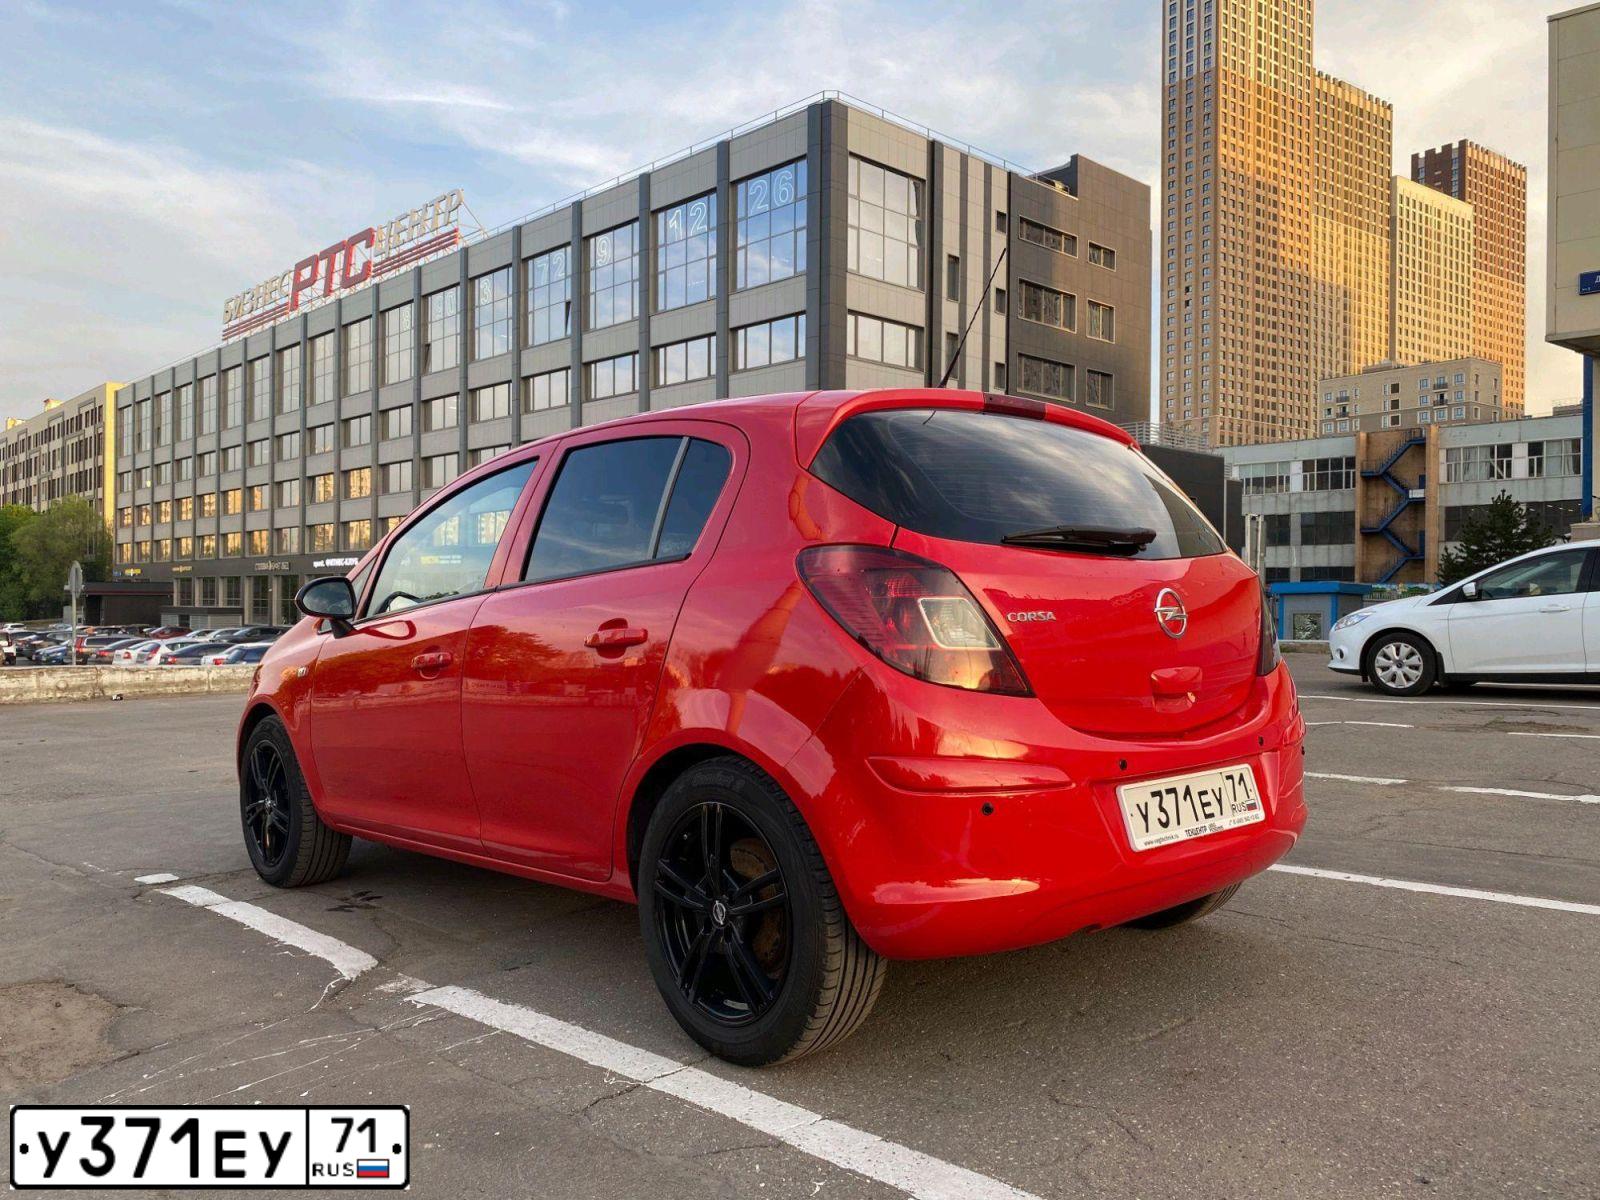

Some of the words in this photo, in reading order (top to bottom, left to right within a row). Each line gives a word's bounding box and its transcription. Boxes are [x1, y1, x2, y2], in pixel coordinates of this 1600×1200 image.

[479, 278, 492, 306] 3
[535, 252, 566, 285] 72
[596, 235, 611, 267] 9
[668, 202, 708, 241] 12
[749, 169, 795, 217] 26
[223, 269, 293, 324] БИЗНЕС
[290, 226, 375, 312] РТС
[373, 188, 463, 259] ЦЕНТР
[1006, 611, 1056, 622] CORSA
[1225, 772, 1250, 801] 71
[1231, 801, 1247, 814] RUS
